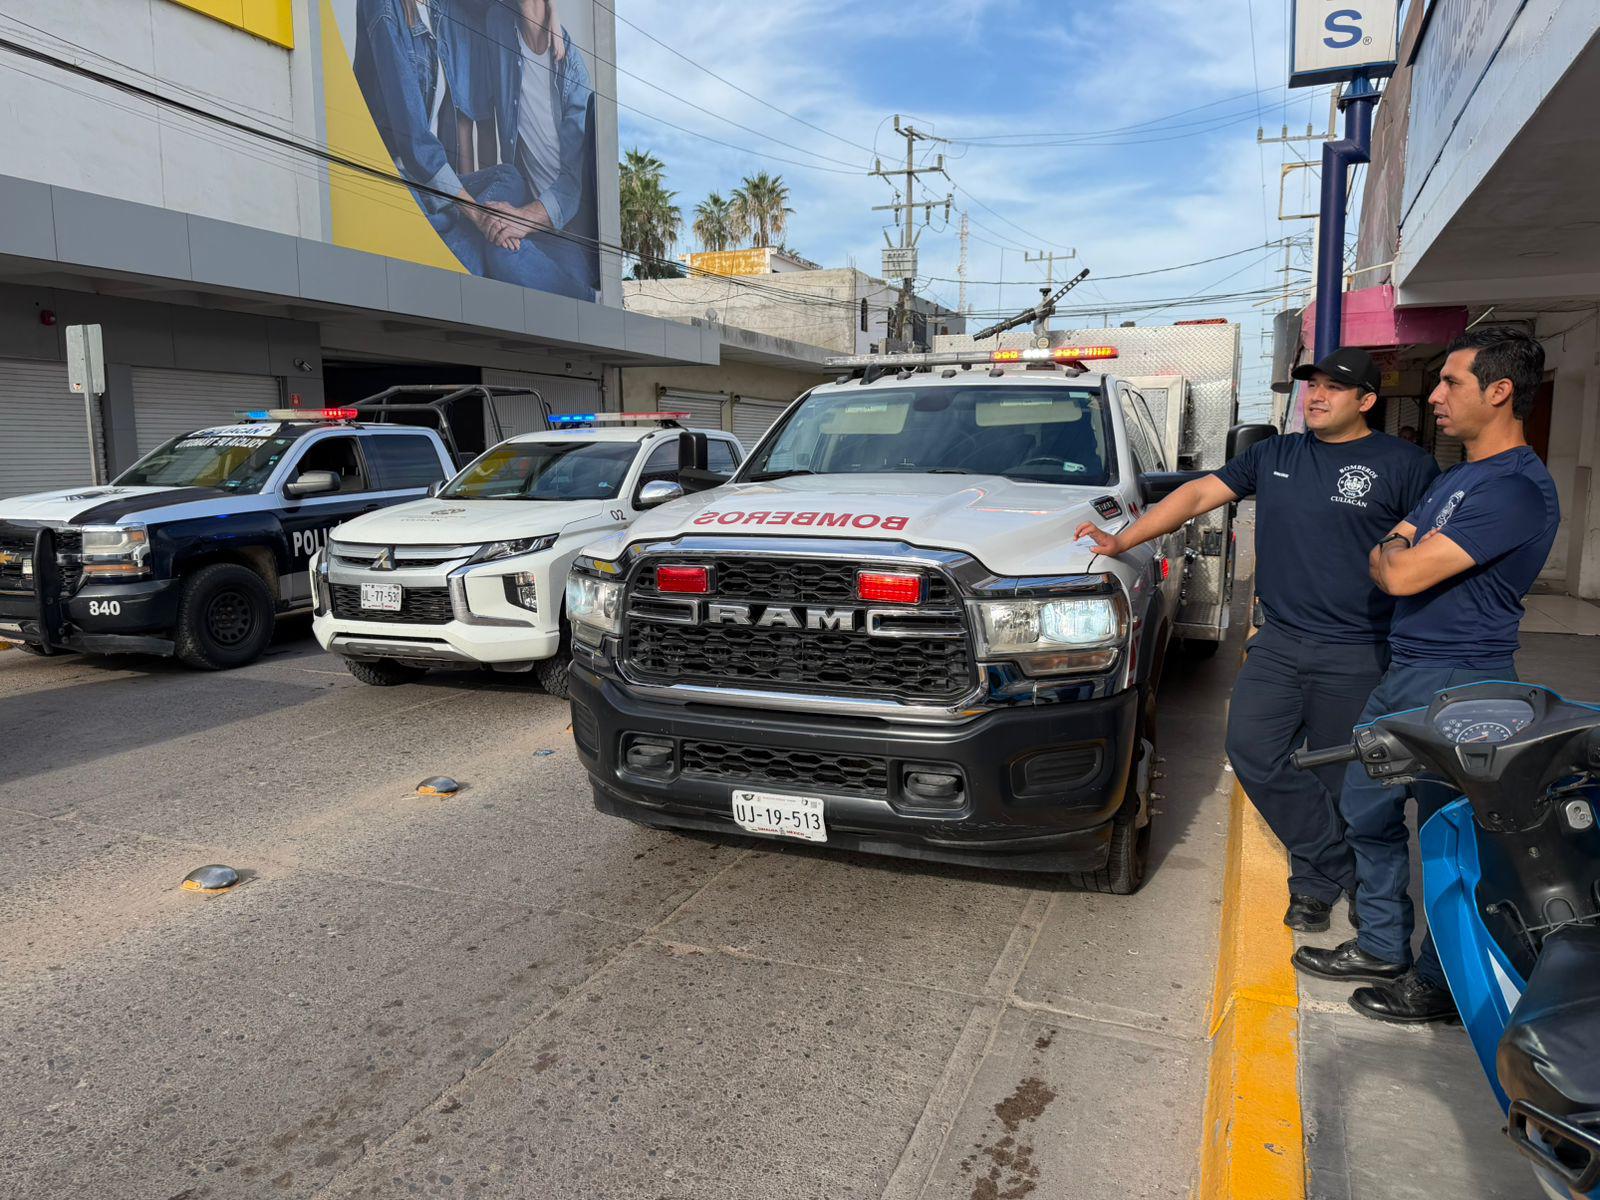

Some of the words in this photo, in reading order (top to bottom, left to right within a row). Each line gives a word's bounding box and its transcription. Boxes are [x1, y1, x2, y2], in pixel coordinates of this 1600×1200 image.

[1339, 465, 1378, 479] BOMBEROS
[610, 509, 627, 521] 02
[89, 600, 121, 616] 840
[708, 602, 856, 631] RAM
[736, 804, 821, 830] UJ-19-513
